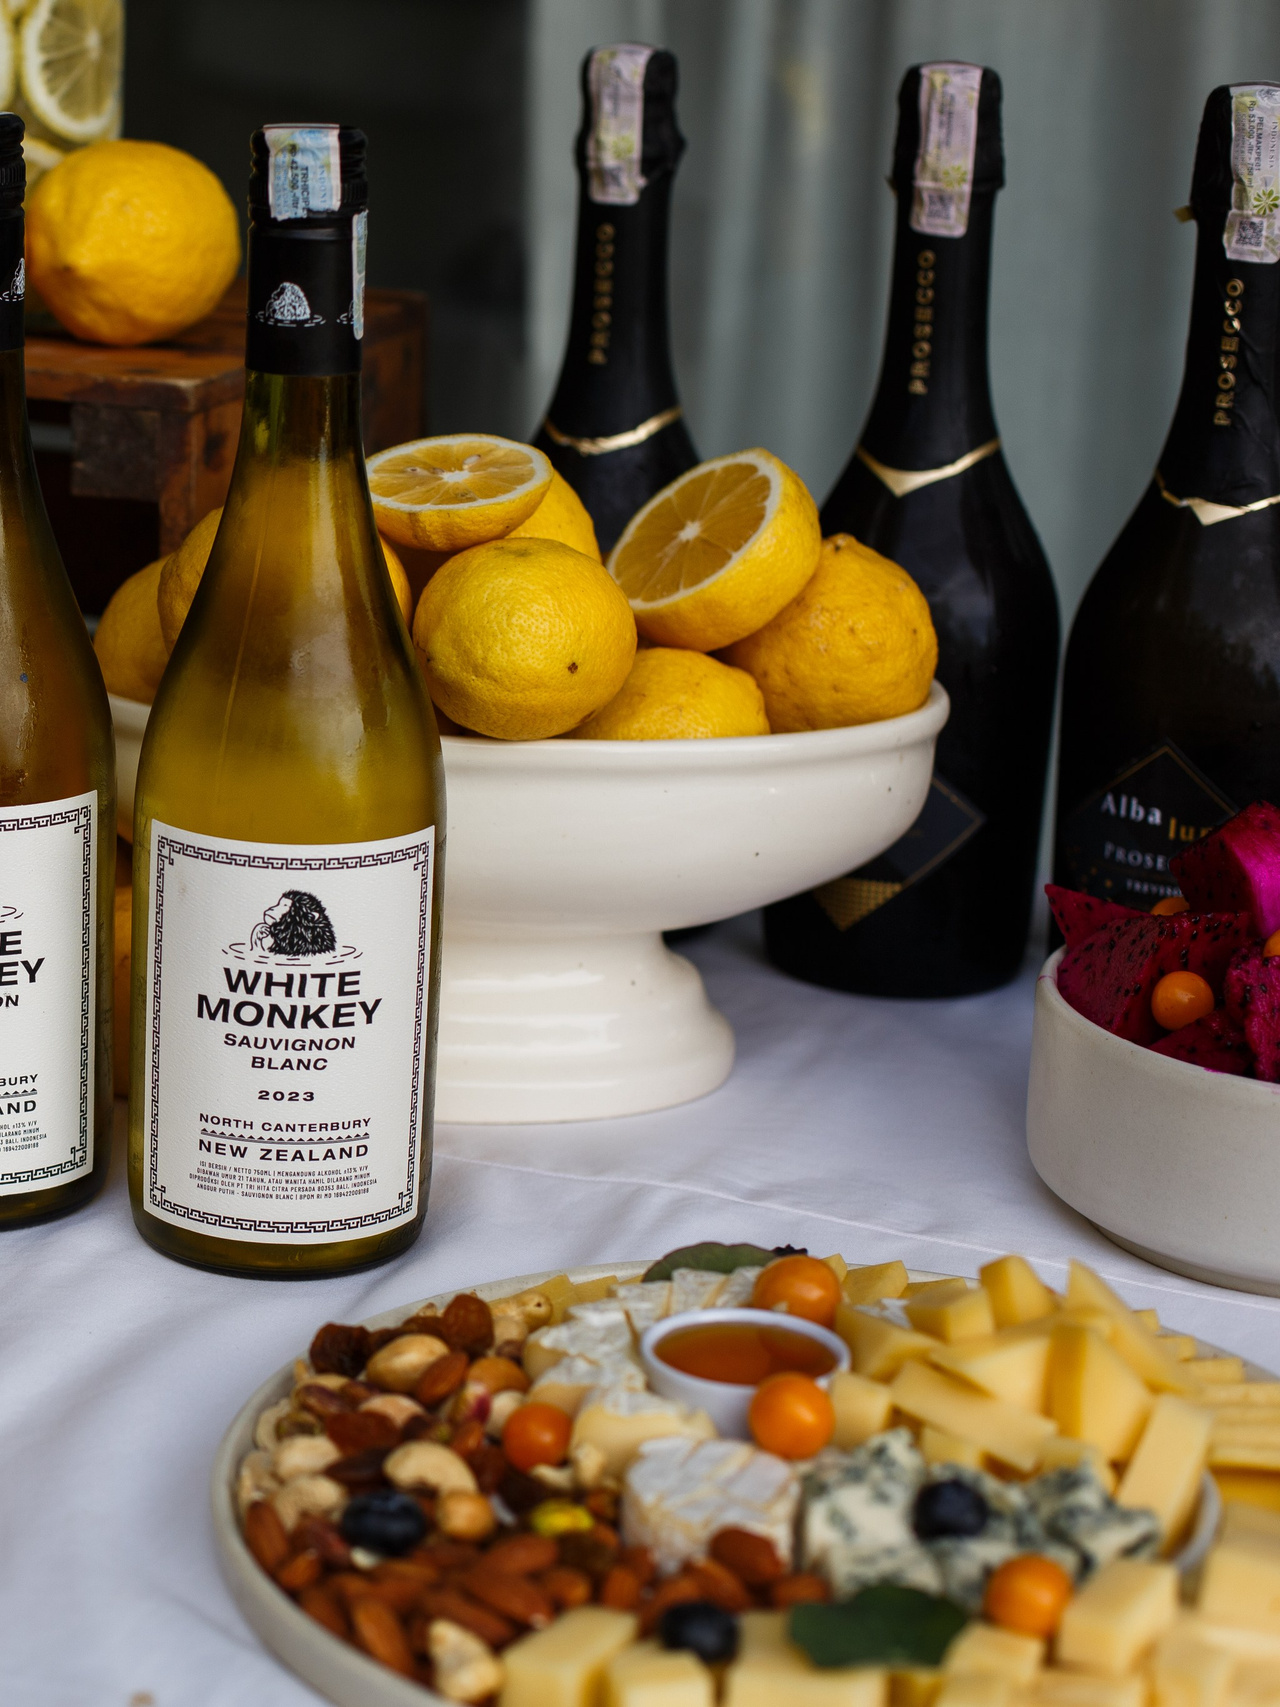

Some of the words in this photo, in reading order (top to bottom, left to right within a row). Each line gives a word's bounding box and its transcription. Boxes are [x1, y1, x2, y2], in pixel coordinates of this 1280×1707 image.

[908, 250, 936, 395] PROSECCO
[1213, 278, 1244, 426] PROSECCO
[1101, 792, 1162, 826] Alba
[1103, 841, 1169, 871] PROSE
[223, 967, 361, 998] WHITE
[197, 994, 382, 1029] MONKEY
[224, 1032, 355, 1051] SAUVIGNON
[251, 1056, 328, 1070] BLANC
[258, 1090, 314, 1101] 2023
[22, 1127, 39, 1135] MINUM
[199, 1113, 253, 1130] NORTH
[262, 1117, 371, 1133] CANTERBURY
[20, 1133, 47, 1143] INDONESIA
[199, 1139, 248, 1159] NEW
[260, 1143, 368, 1161] ZEALAND
[196, 1167, 219, 1178] DIBAWAH
[221, 1172, 236, 1180] UMUR
[326, 1174, 352, 1183] DILARANG
[208, 1162, 227, 1172] BERSIH
[233, 1166, 251, 1175] NETTO
[317, 1168, 341, 1176] ALKOHOL
[196, 1182, 216, 1192] ANGGUR
[218, 1186, 234, 1195] PUTIH
[241, 1190, 273, 1199] SAUVIGNON
[220, 1179, 234, 1188] OLEH
[351, 1178, 377, 1188] INDONESIA
